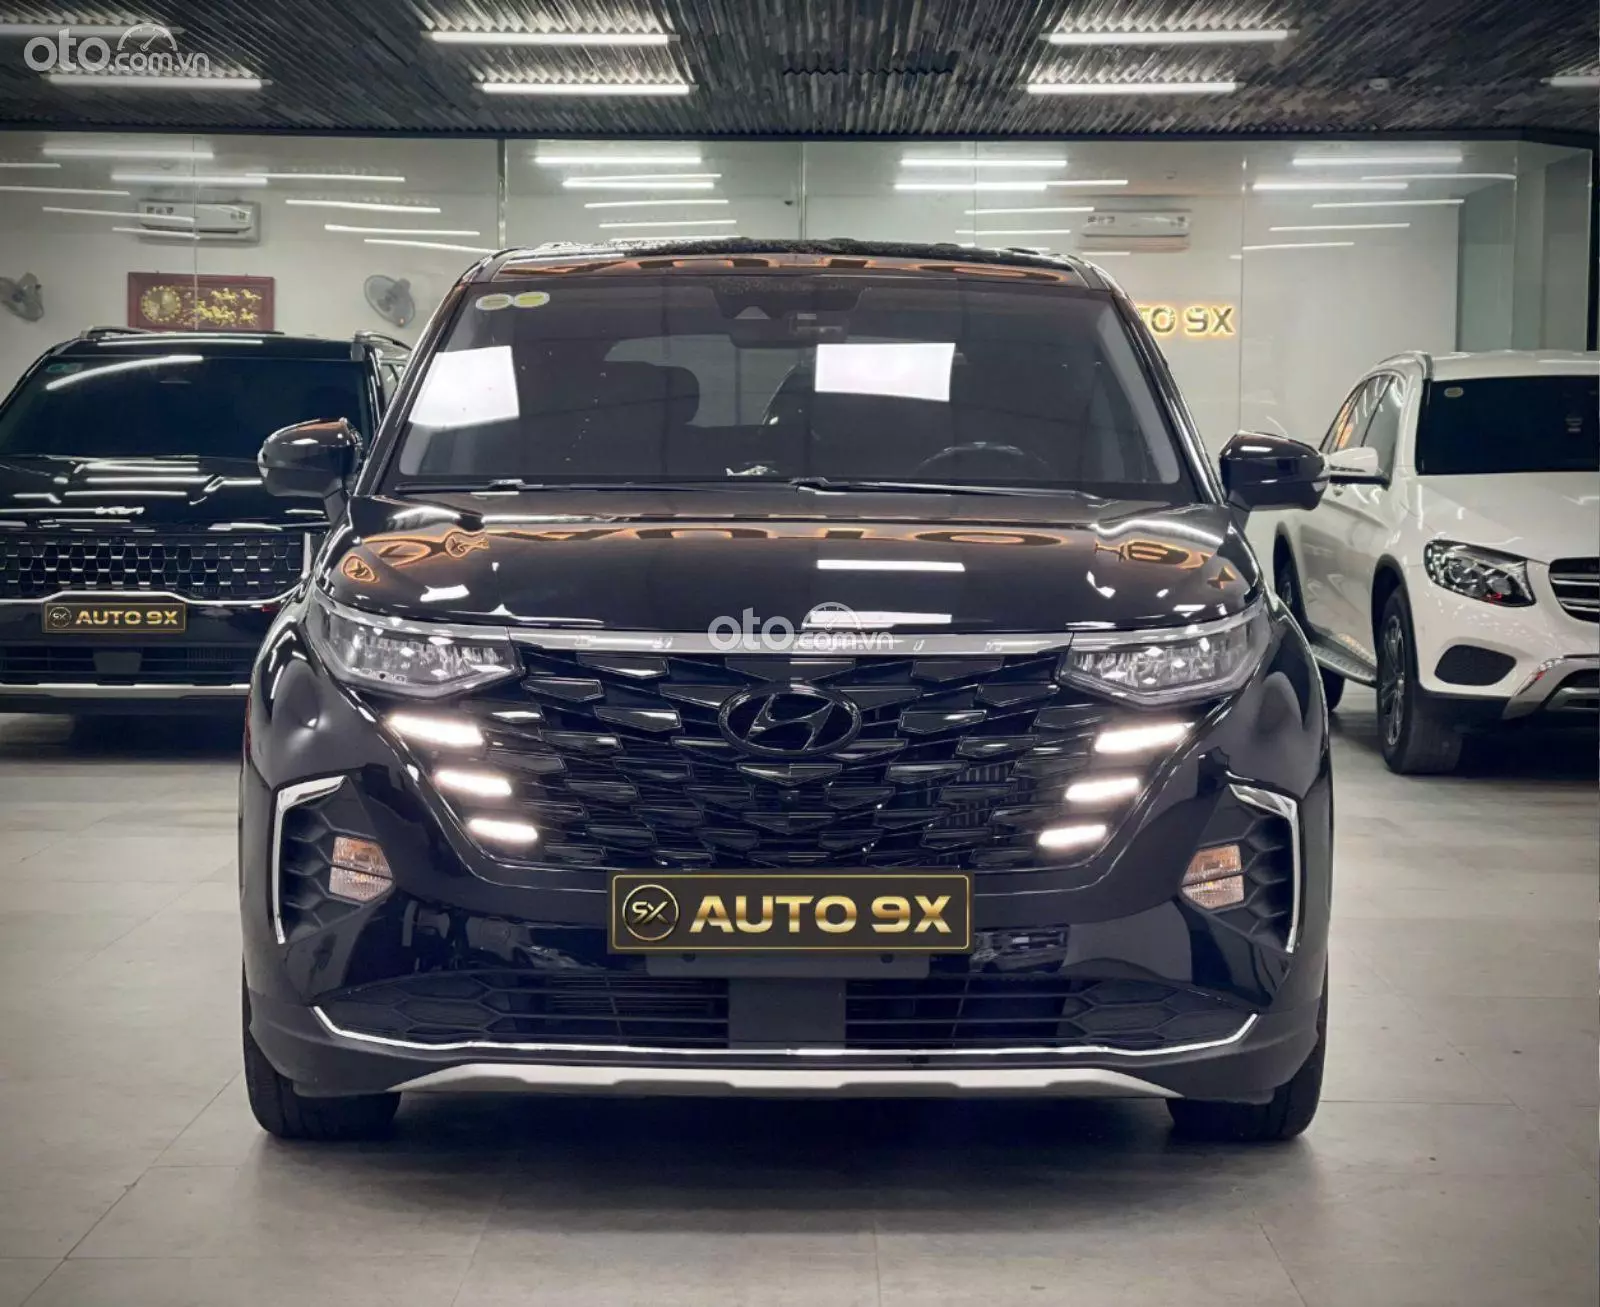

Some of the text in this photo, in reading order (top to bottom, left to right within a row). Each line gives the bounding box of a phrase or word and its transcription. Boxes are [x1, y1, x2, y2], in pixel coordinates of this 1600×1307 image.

[1185, 306, 1234, 334] 9X
[75, 610, 178, 625] AUTO 9X
[631, 901, 670, 925] 9X
[688, 895, 952, 933] AUTO 9X
